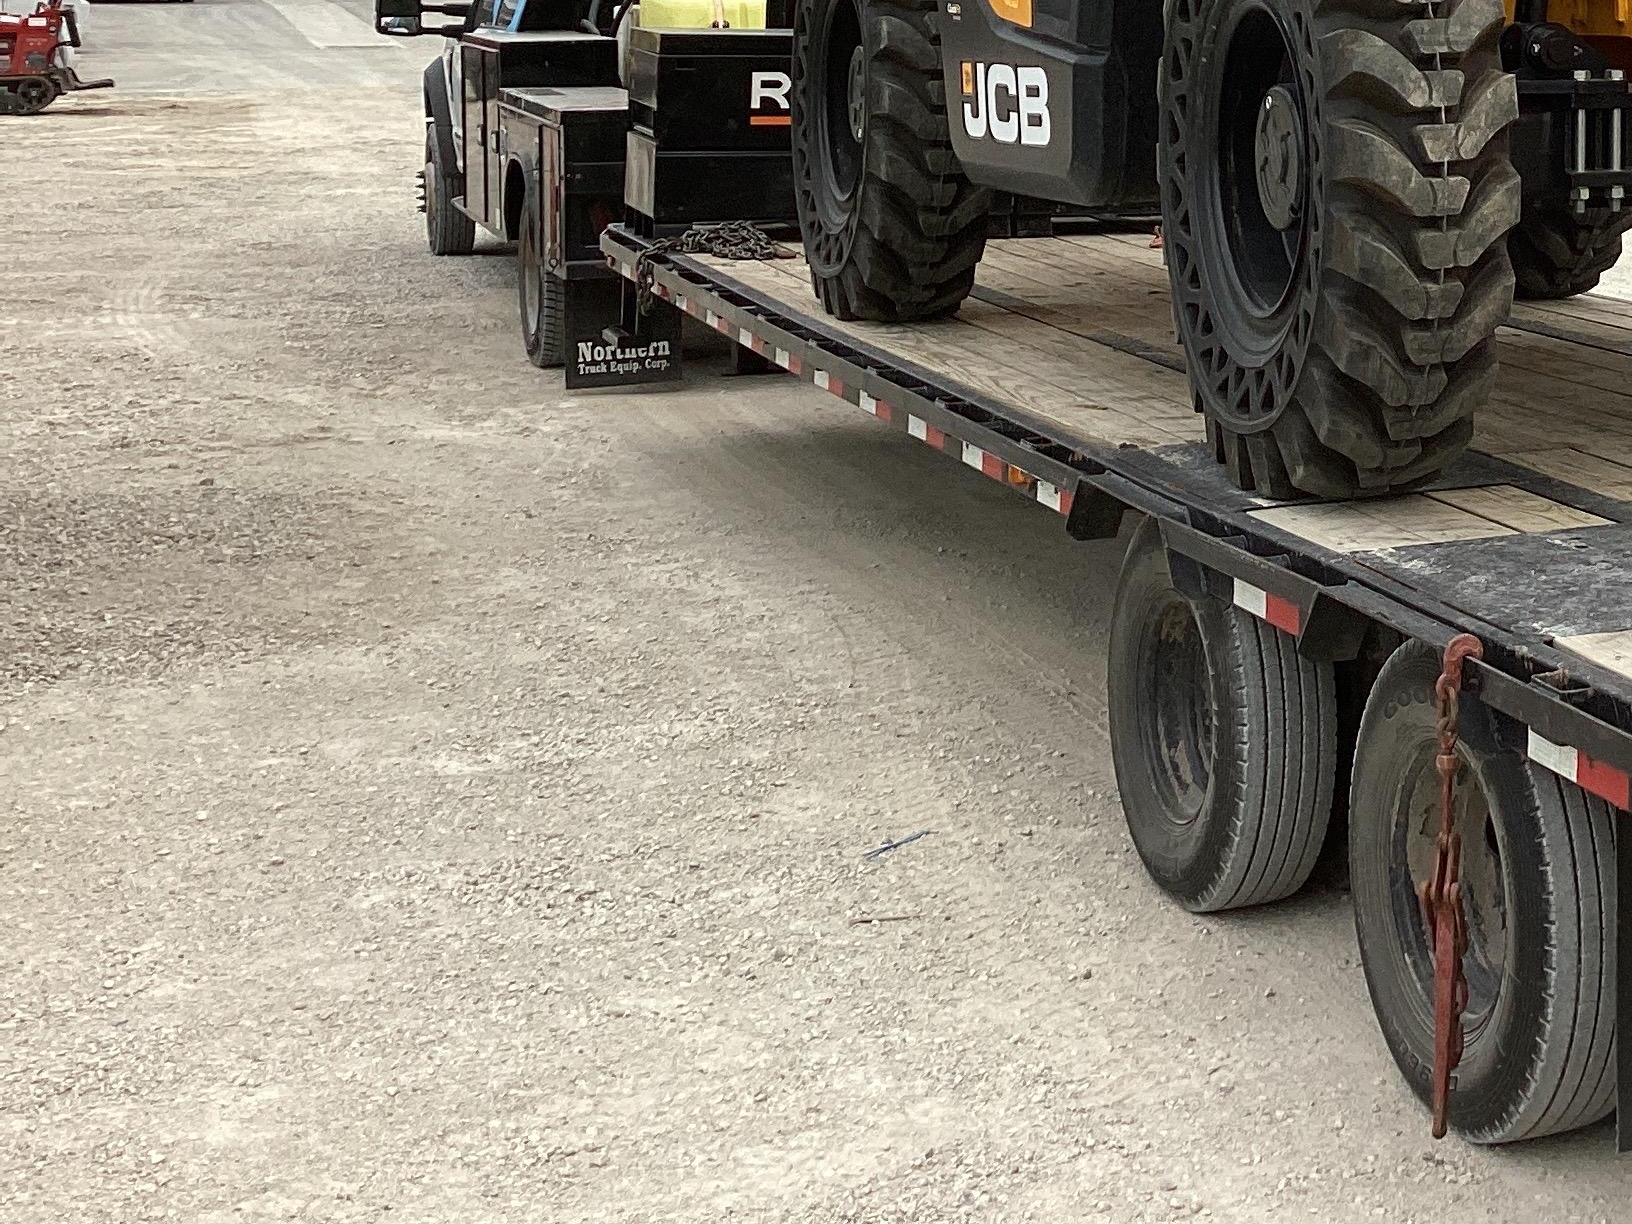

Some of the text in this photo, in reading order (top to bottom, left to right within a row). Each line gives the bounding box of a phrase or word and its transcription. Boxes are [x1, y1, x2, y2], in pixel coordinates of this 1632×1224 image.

[751, 71, 792, 109] R
[963, 62, 1051, 146] JCB
[578, 358, 670, 375] Truck Equip. Corp.
